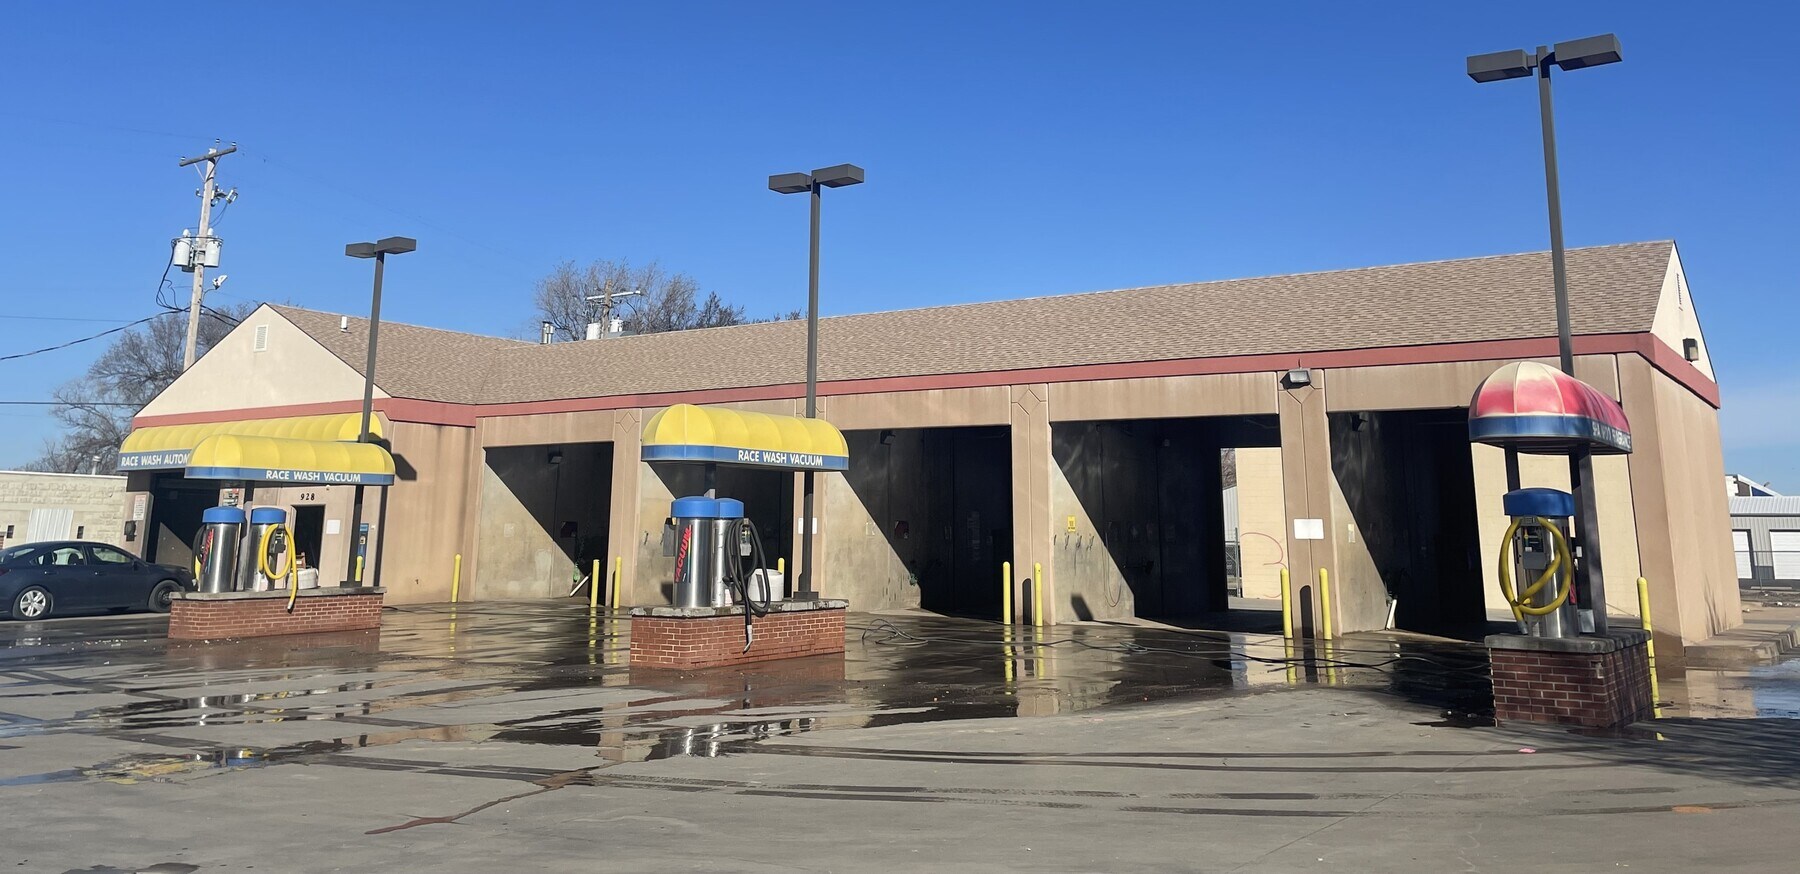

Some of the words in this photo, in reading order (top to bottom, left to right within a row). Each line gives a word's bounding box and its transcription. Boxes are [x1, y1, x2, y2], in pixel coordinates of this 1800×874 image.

[120, 456, 139, 467] RACE
[141, 454, 162, 466] WASH
[738, 450, 760, 462] RACE
[763, 451, 787, 464] WASH
[789, 453, 823, 466] VACUUM
[265, 470, 290, 480] RACE
[293, 471, 321, 481] WASH
[323, 472, 361, 483] VACUUM
[300, 492, 316, 501] 928
